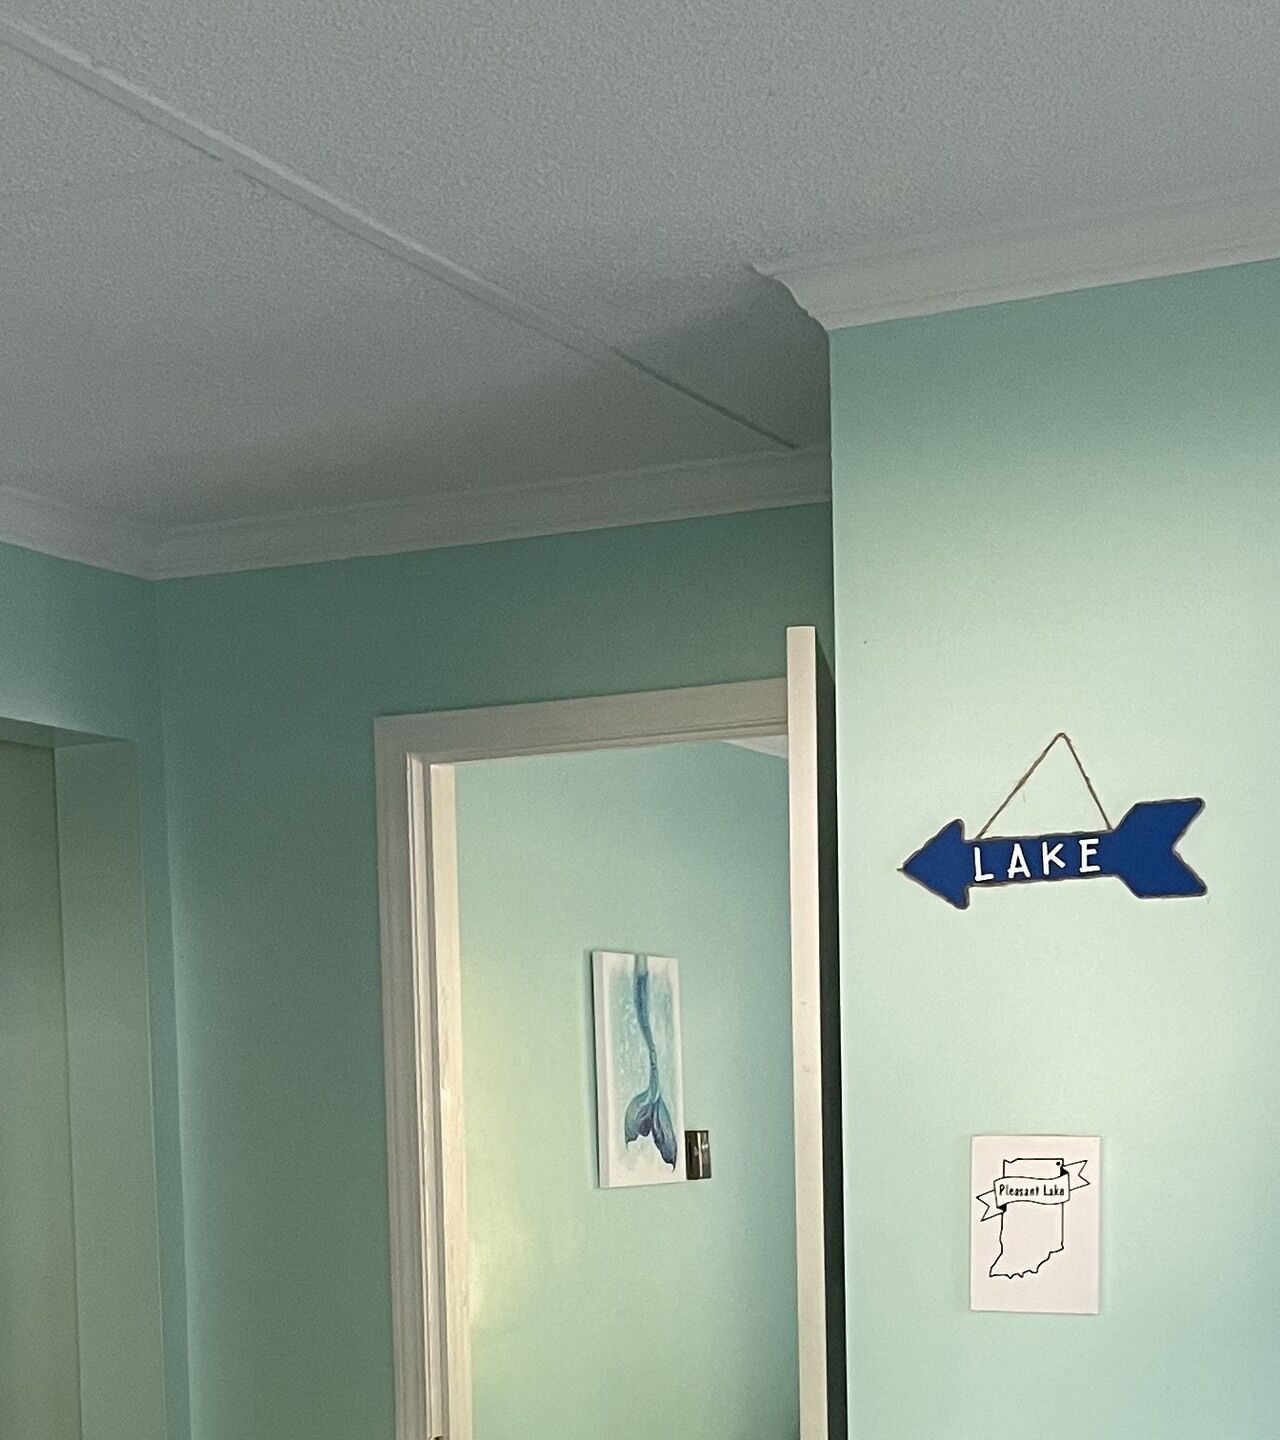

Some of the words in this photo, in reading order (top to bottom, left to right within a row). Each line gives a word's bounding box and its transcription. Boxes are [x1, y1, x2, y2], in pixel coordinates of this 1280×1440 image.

[972, 837, 1102, 882] LAKE
[999, 1184, 1039, 1197] Pleasant
[1043, 1184, 1065, 1197] Lake
